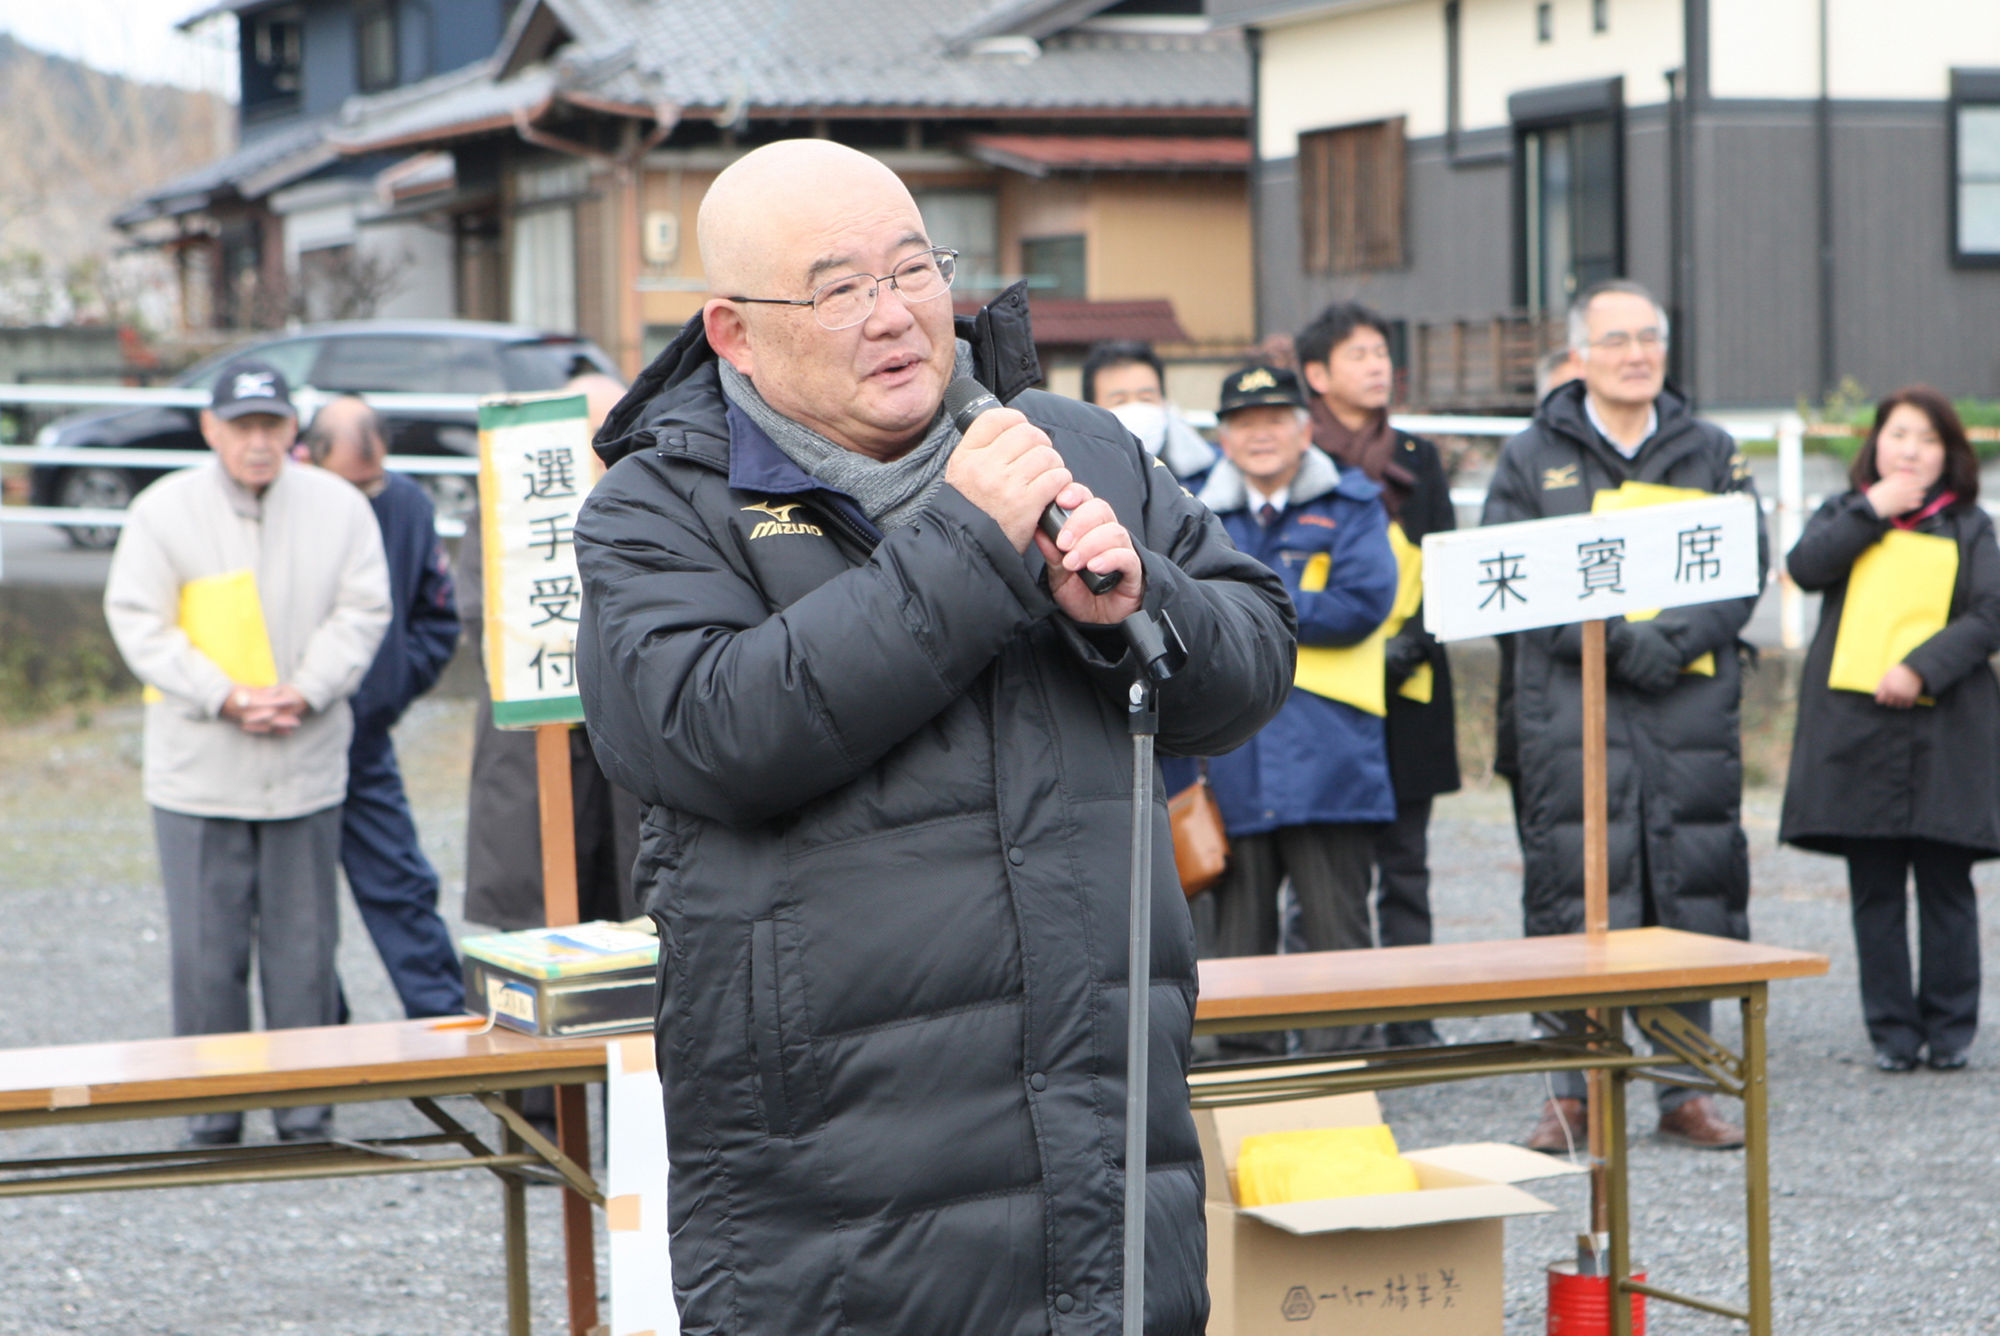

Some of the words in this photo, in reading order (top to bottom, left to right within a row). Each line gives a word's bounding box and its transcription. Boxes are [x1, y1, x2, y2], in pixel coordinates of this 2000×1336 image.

[522, 448, 580, 690] 選手受付
[1478, 524, 1723, 611] 来賓席
